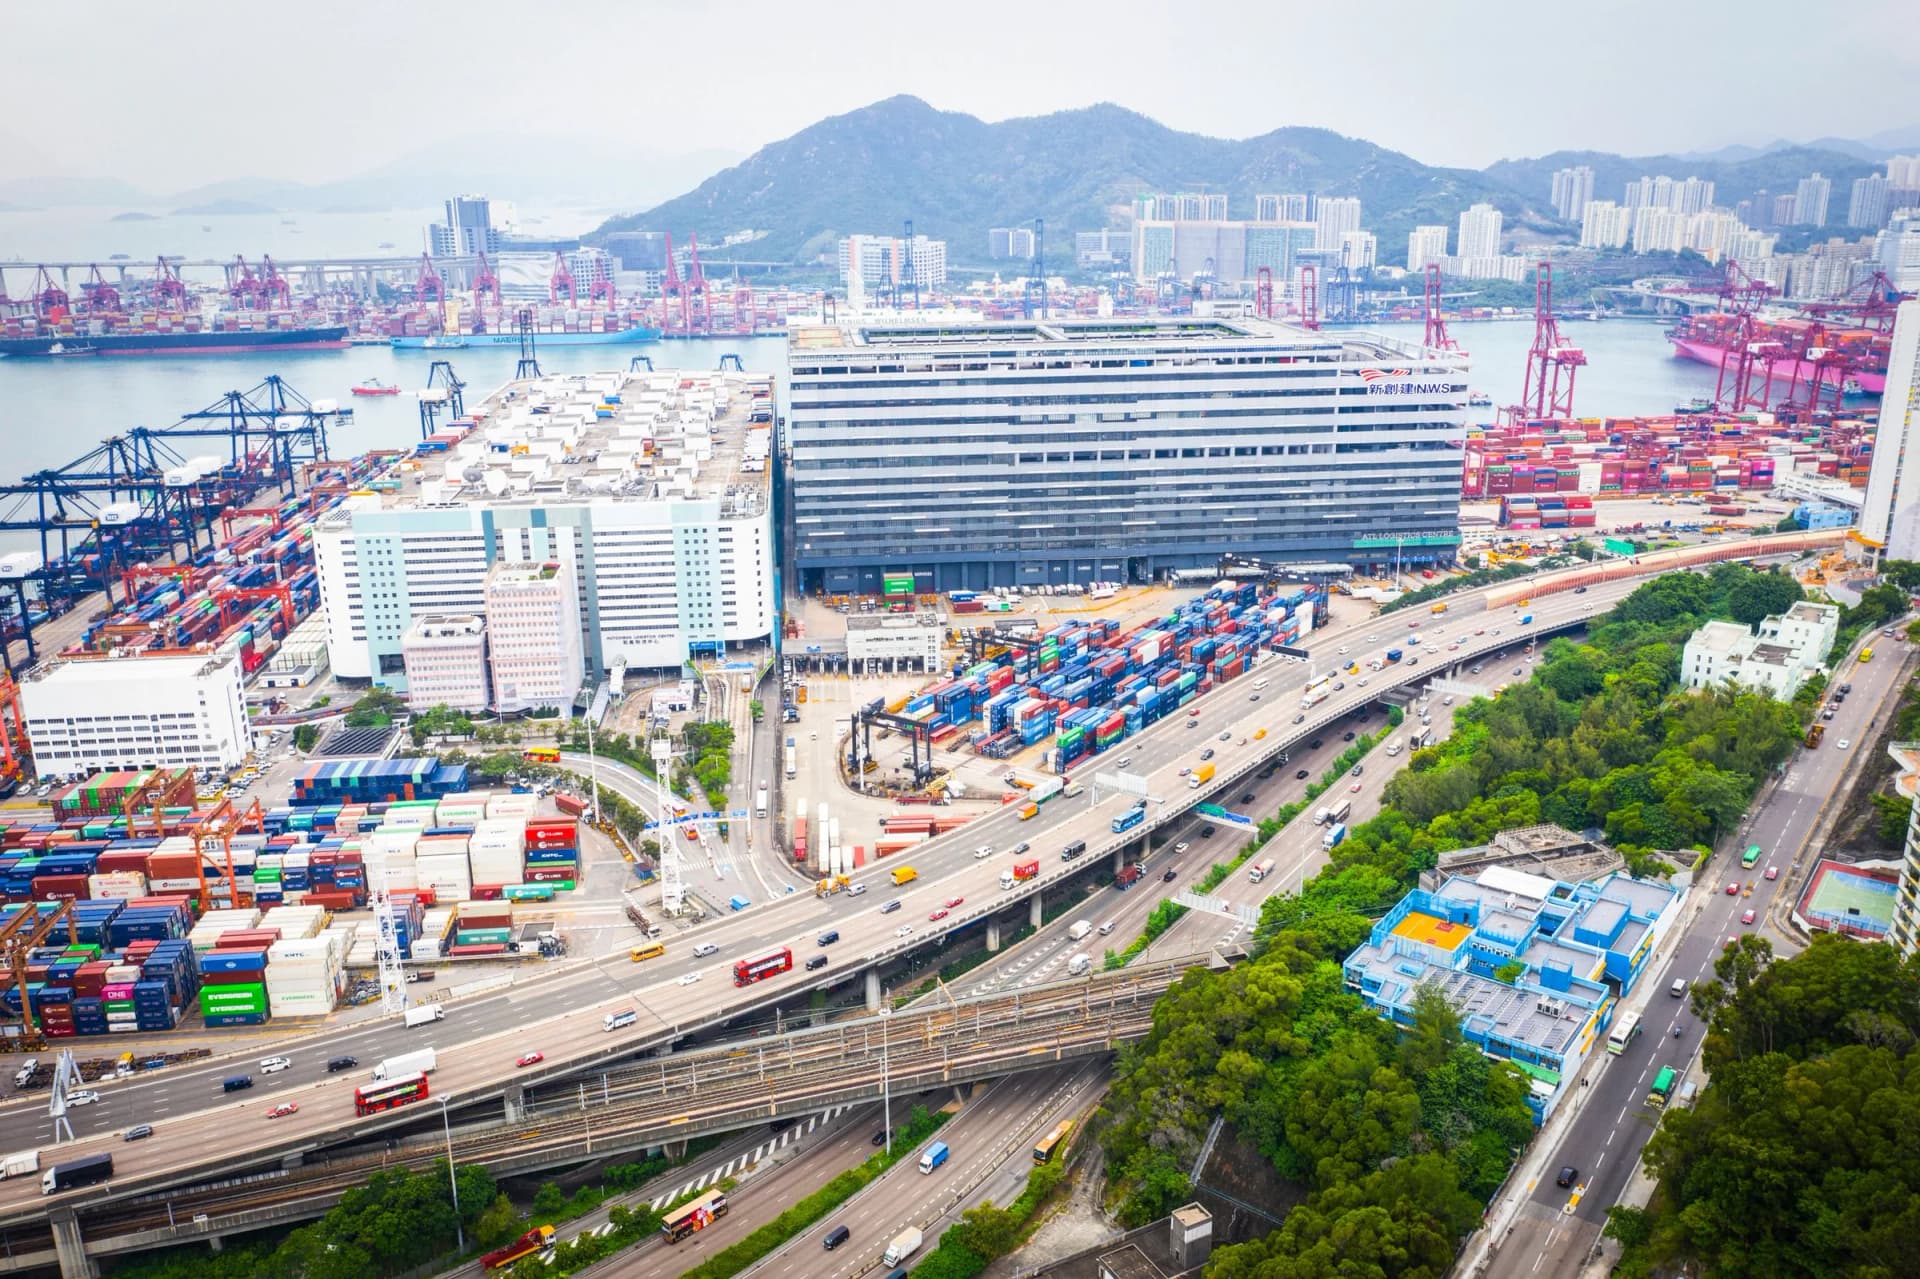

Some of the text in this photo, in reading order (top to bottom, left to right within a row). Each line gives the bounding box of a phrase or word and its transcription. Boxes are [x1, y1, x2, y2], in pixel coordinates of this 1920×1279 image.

[1368, 383, 1450, 395] 新創建 NWS
[1379, 531, 1419, 539] LOGISTICS
[1421, 530, 1454, 538] CENTRE
[107, 991, 126, 999] ONE
[207, 992, 253, 1000] EVERGREEN
[209, 1004, 255, 1013] EVERGREEN
